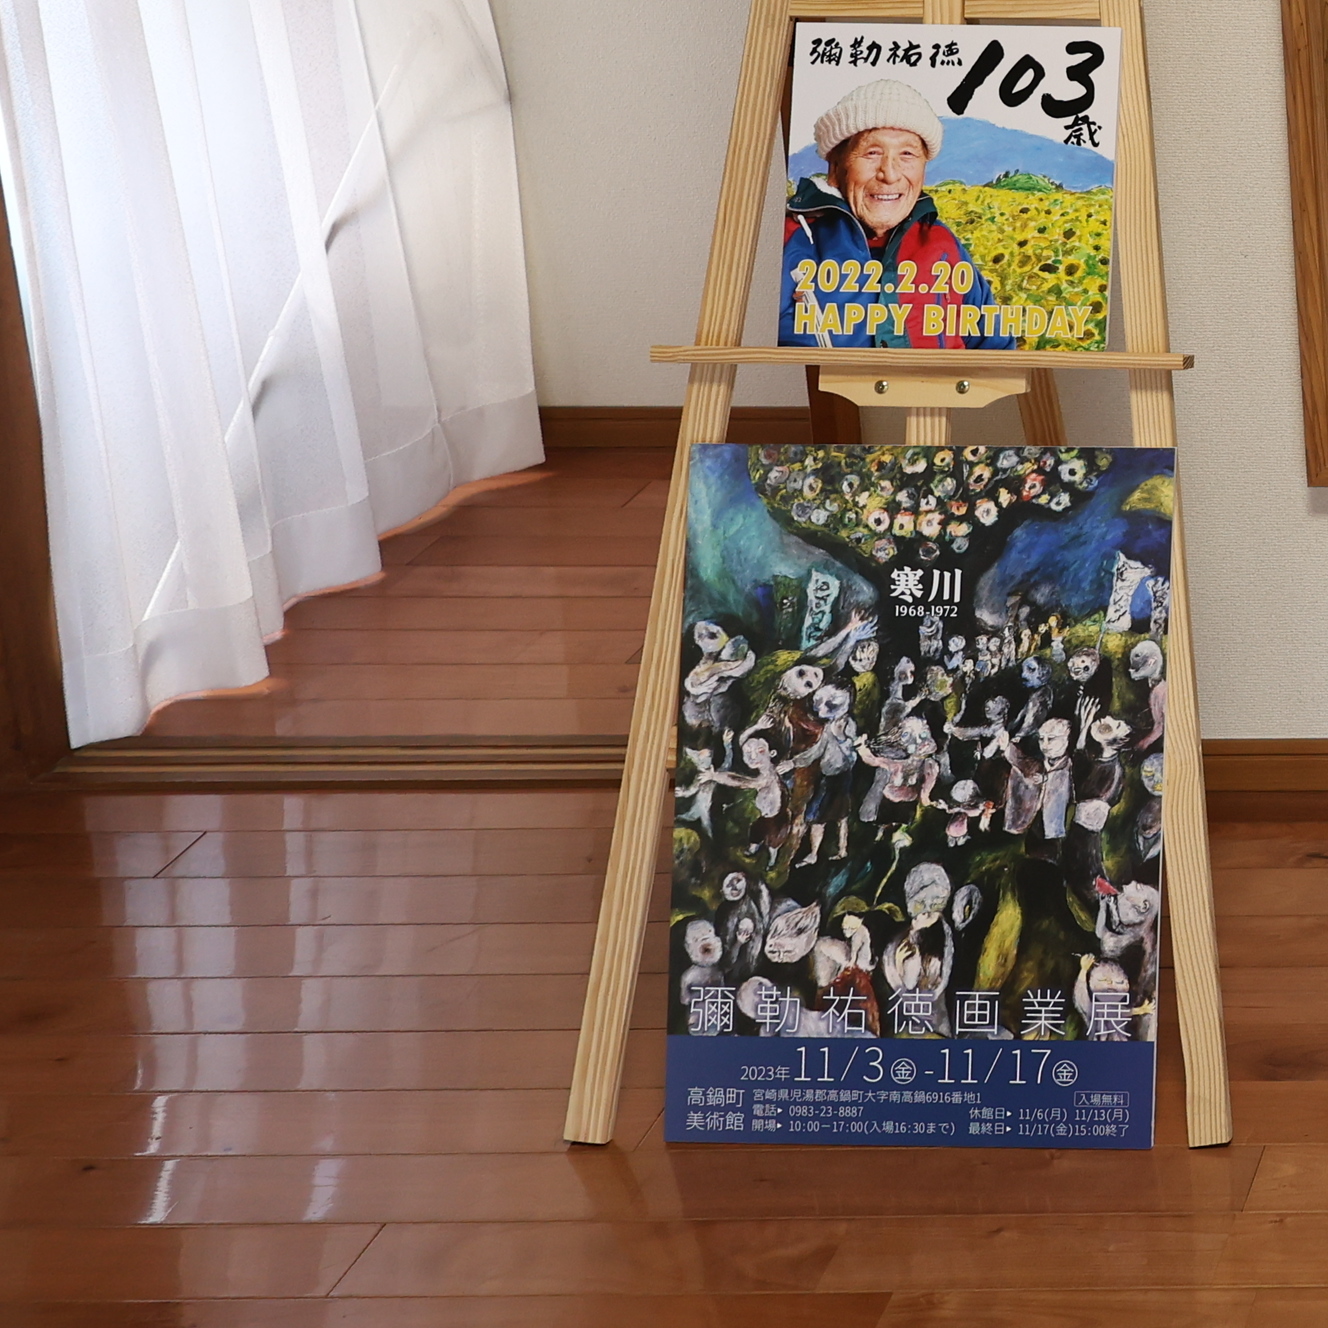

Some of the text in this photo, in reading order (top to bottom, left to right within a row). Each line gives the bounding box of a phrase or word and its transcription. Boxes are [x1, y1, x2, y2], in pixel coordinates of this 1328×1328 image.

[946, 39, 1105, 118] 103
[1063, 114, 1103, 148] 歳
[795, 259, 974, 295] 2022.2.20
[793, 302, 1092, 338] HAPPY BIRTHDAY
[889, 566, 963, 603] 寒川
[895, 605, 958, 617] 1968-1972
[687, 1087, 745, 1108] 高鍋町
[1078, 1093, 1124, 1106] 入場無料
[685, 1110, 745, 1131] 美術館
[788, 1105, 864, 1118] 0983-23-8887
